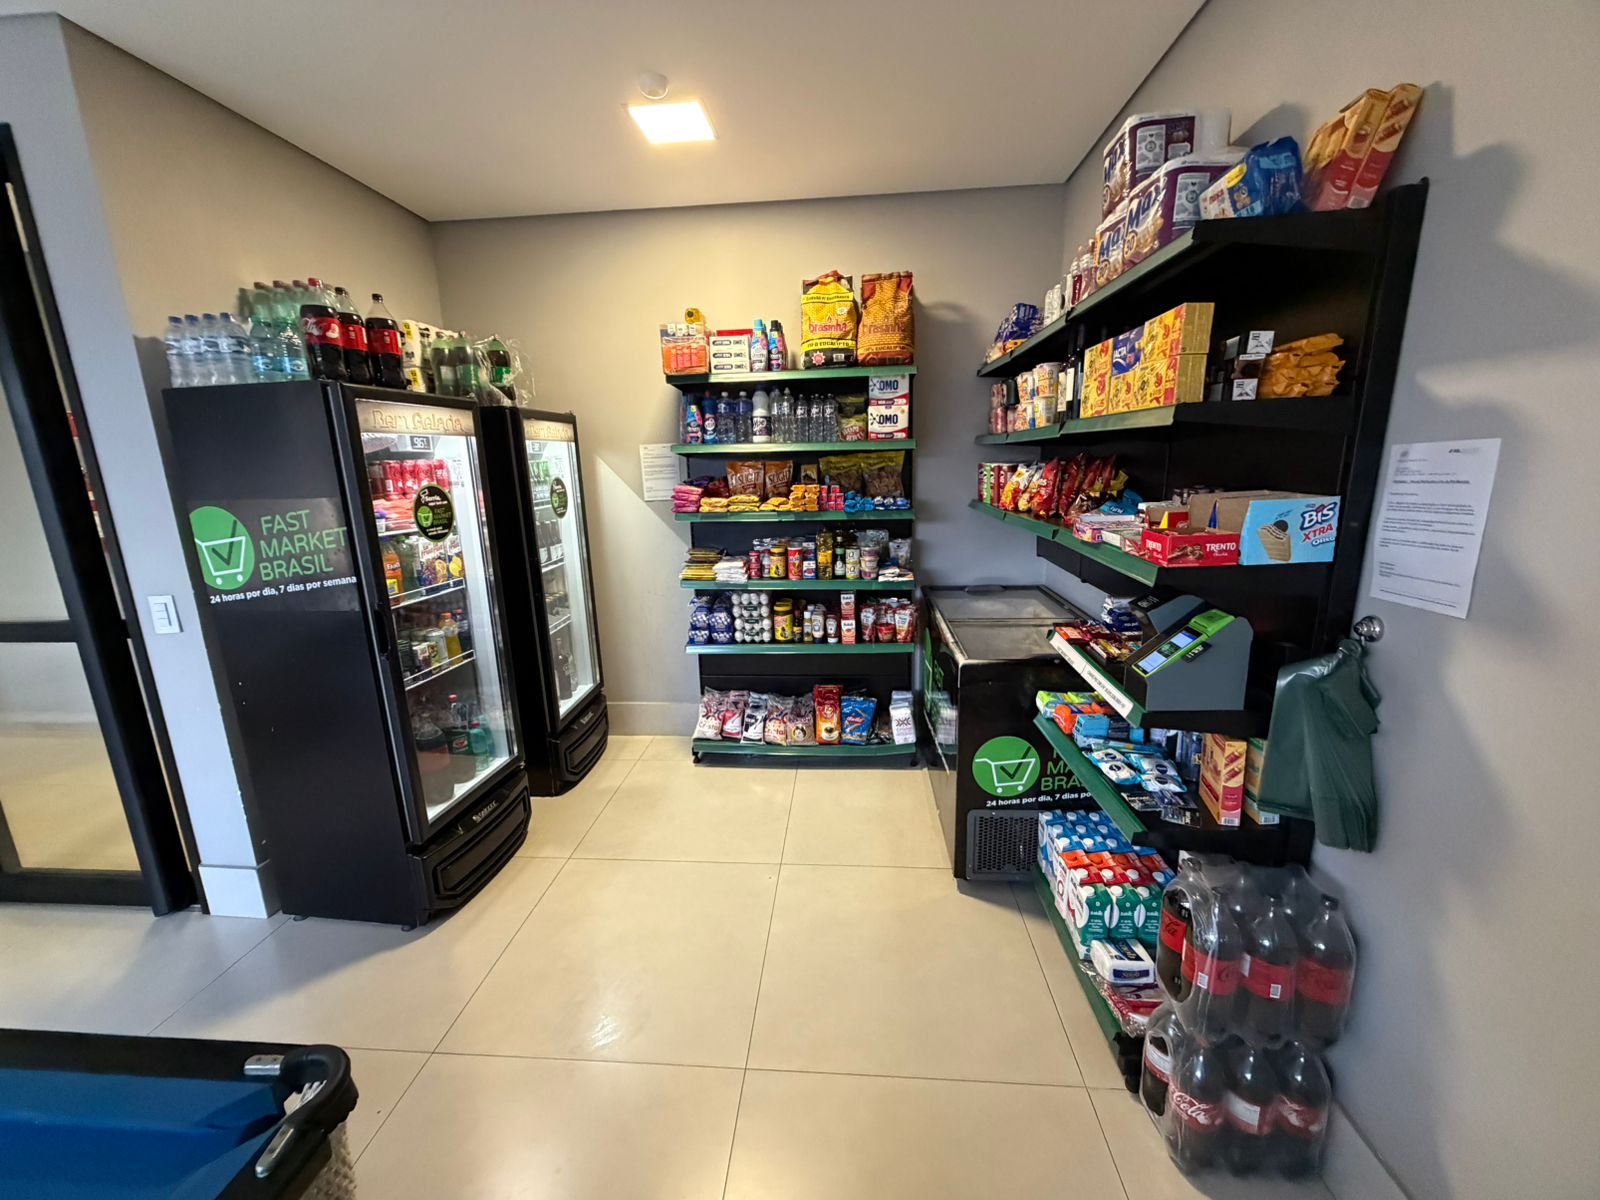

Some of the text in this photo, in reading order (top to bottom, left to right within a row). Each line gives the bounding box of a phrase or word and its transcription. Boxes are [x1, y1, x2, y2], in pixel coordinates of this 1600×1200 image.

[879, 379, 899, 391] OMO
[879, 414, 899, 425] OMO
[260, 509, 310, 535] FAST
[259, 526, 347, 558] MARKET
[1302, 523, 1334, 543] XTRA
[1205, 542, 1237, 552] TRENTO
[259, 553, 334, 582] BRASIL
[209, 575, 357, 604] 24 horas por dia, 7 dias por semana
[1041, 775, 1087, 791] BRA
[998, 798, 1021, 806] horas
[1061, 792, 1079, 800] dias
